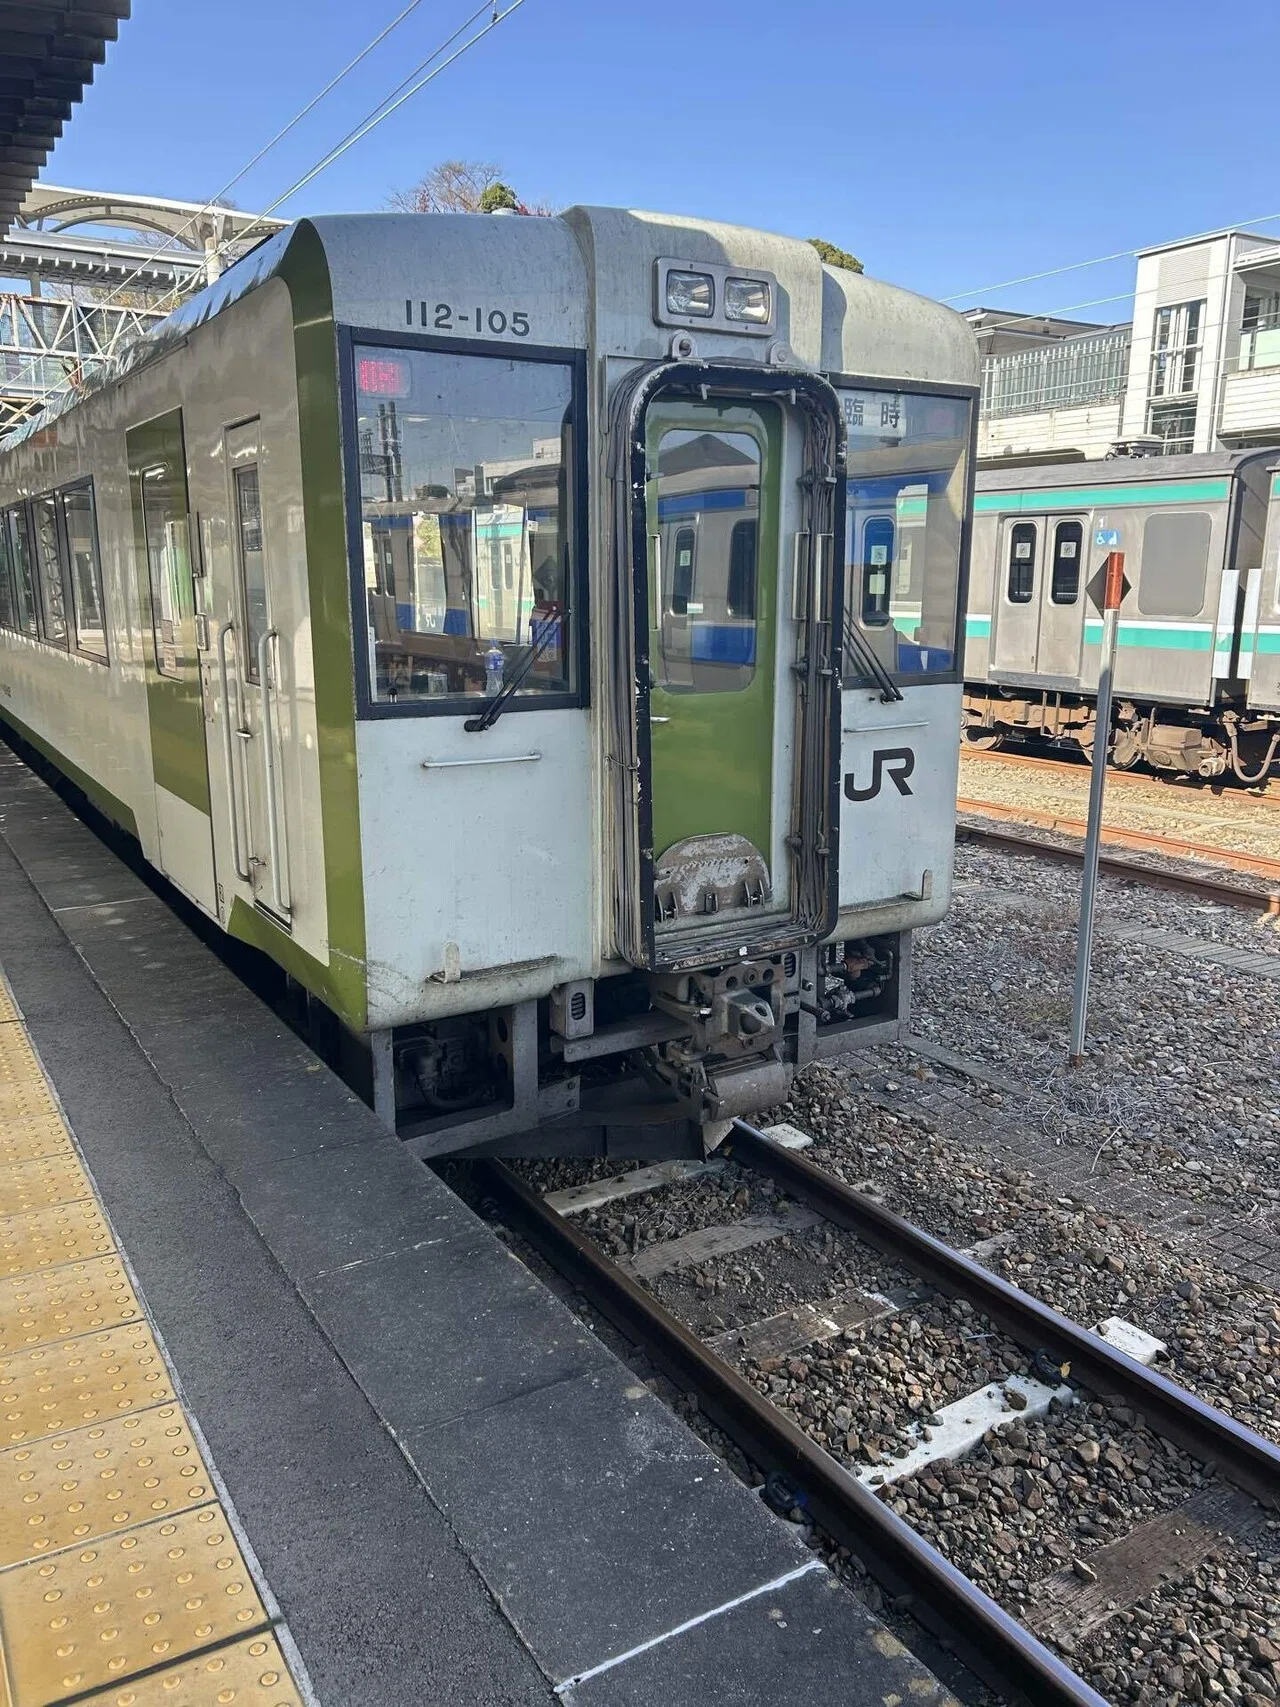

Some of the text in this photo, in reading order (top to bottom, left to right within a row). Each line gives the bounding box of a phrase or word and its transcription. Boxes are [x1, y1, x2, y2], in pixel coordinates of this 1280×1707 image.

[405, 299, 531, 337] 112-105
[844, 393, 900, 429] 臨時
[844, 747, 915, 802] JR
